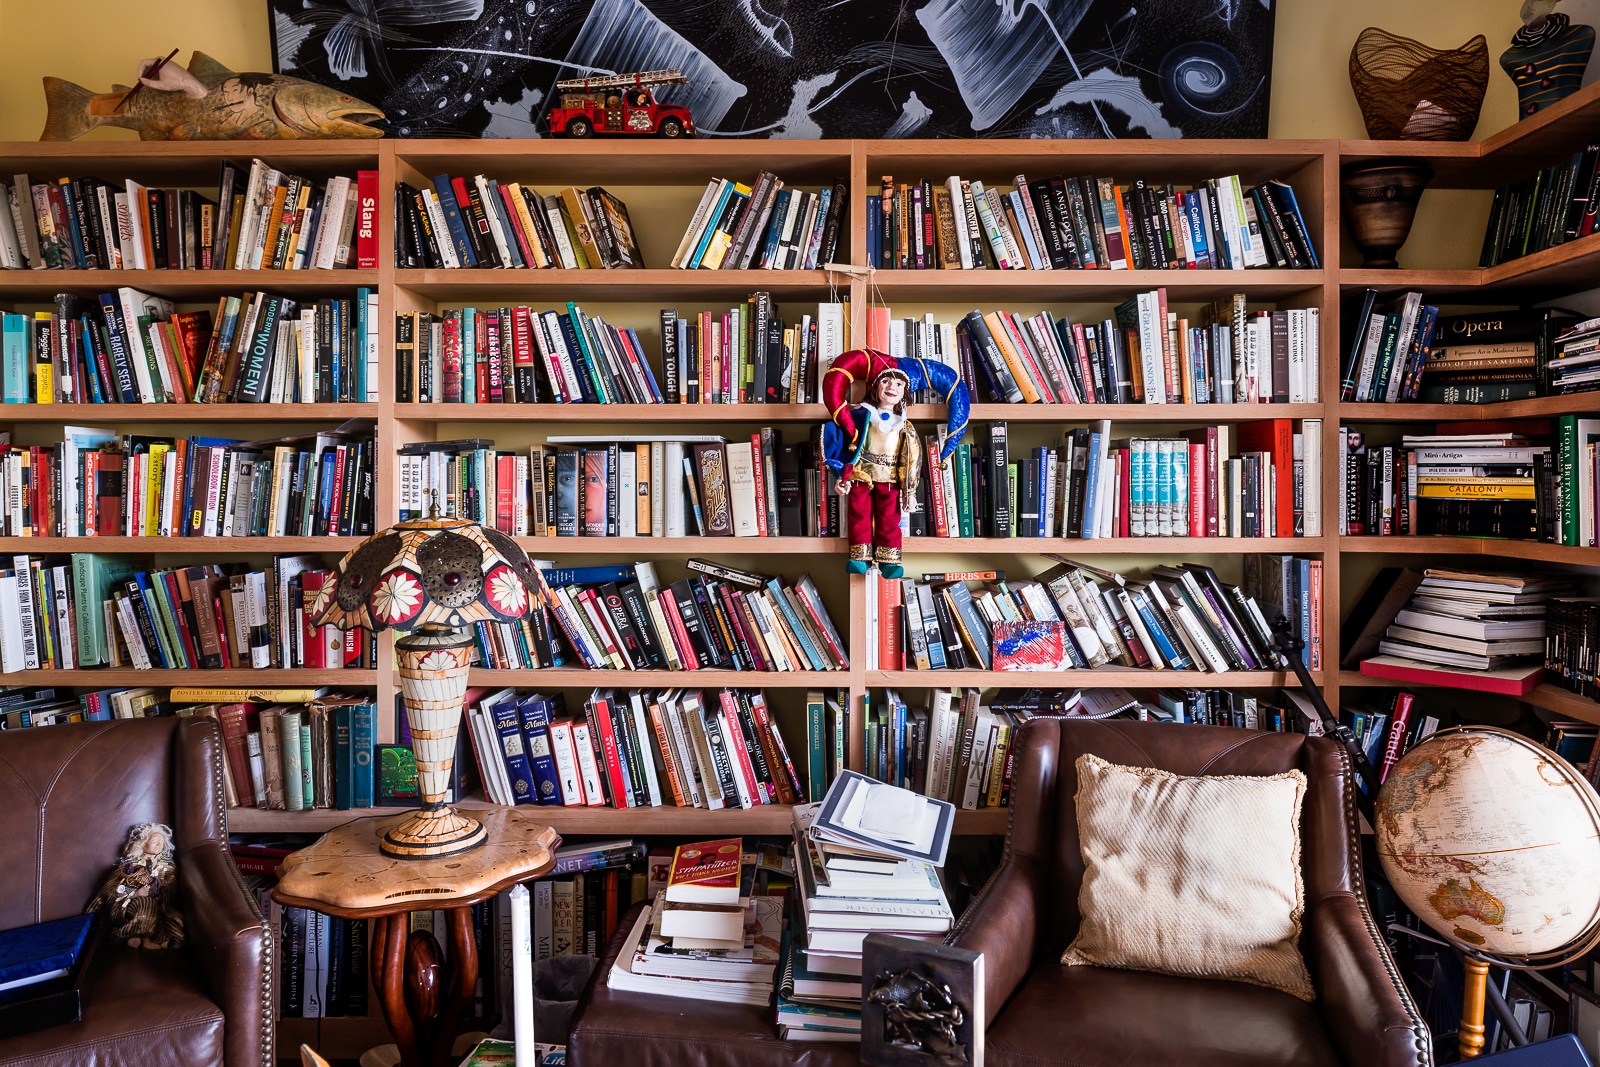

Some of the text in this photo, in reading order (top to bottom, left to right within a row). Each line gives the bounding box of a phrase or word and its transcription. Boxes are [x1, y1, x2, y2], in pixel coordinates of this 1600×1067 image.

[63, 186, 71, 205] CONTENT
[76, 200, 84, 211] The
[88, 195, 97, 215] HISTORY
[1266, 195, 1278, 215] MURDER
[77, 211, 86, 225] New
[360, 197, 375, 238] Slang
[434, 202, 444, 216] WRITE
[965, 197, 978, 235] TRIANGLE
[78, 226, 87, 236] Jim
[91, 215, 100, 236] THIEVES
[117, 202, 132, 242] sonnets
[294, 211, 303, 232] WAGNER
[1056, 190, 1076, 254] ANGELOLOGY
[1181, 218, 1190, 240] Oregon
[1191, 207, 1201, 243] California
[342, 224, 351, 244] Classics
[551, 212, 569, 253] NIETZSCHE
[81, 237, 90, 252] Crow
[758, 295, 767, 320] Murder
[304, 322, 313, 351] Peterson
[503, 315, 512, 344] EINSTEIN
[517, 310, 529, 360] WASHINGTON
[552, 323, 562, 339] Stein
[1142, 313, 1151, 352] GRAPHIC
[1452, 319, 1504, 336] Opera
[40, 328, 50, 358] Blogging
[244, 299, 278, 390] MODERN WOMEN
[370, 343, 375, 353] WA
[1385, 334, 1394, 351] Making
[109, 336, 132, 391] RARELY SEEN
[147, 348, 156, 370] TOWNS
[488, 328, 498, 386] KIERKEGAARD
[664, 320, 677, 392] TEXAS TOUGH
[1488, 357, 1535, 366] SAMURAI
[996, 450, 1004, 466] BIRD
[208, 454, 220, 510] SCHOOLBOOK NATION
[1564, 425, 1572, 525] FLORA BRITANNICA
[934, 485, 942, 499] Drives
[936, 505, 944, 525] America
[78, 558, 87, 587] Landscape
[17, 569, 34, 656] IMAGES FROM THE FLOATING WORLD
[176, 609, 185, 626] Florence
[238, 601, 246, 624] RESTLESS
[82, 613, 90, 634] California
[703, 604, 722, 650] STRANGER MAGIC
[497, 721, 519, 729] Music
[524, 721, 546, 729] Music
[730, 721, 739, 731] Plant
[732, 732, 743, 750] Evolution
[759, 709, 780, 768] ACRYLIC INNOVATION
[960, 729, 974, 766] GLOBES
[659, 733, 674, 772] GREAT OUTDOORS
[755, 745, 769, 777] ORCHIDS
[996, 752, 1006, 773] LORD
[713, 745, 730, 782] ARCTIC AMBITIONS
[678, 860, 738, 874] SYMPATHIZER
[554, 900, 572, 910] NEW
[554, 910, 572, 919] YOR
[554, 918, 572, 927] KER
